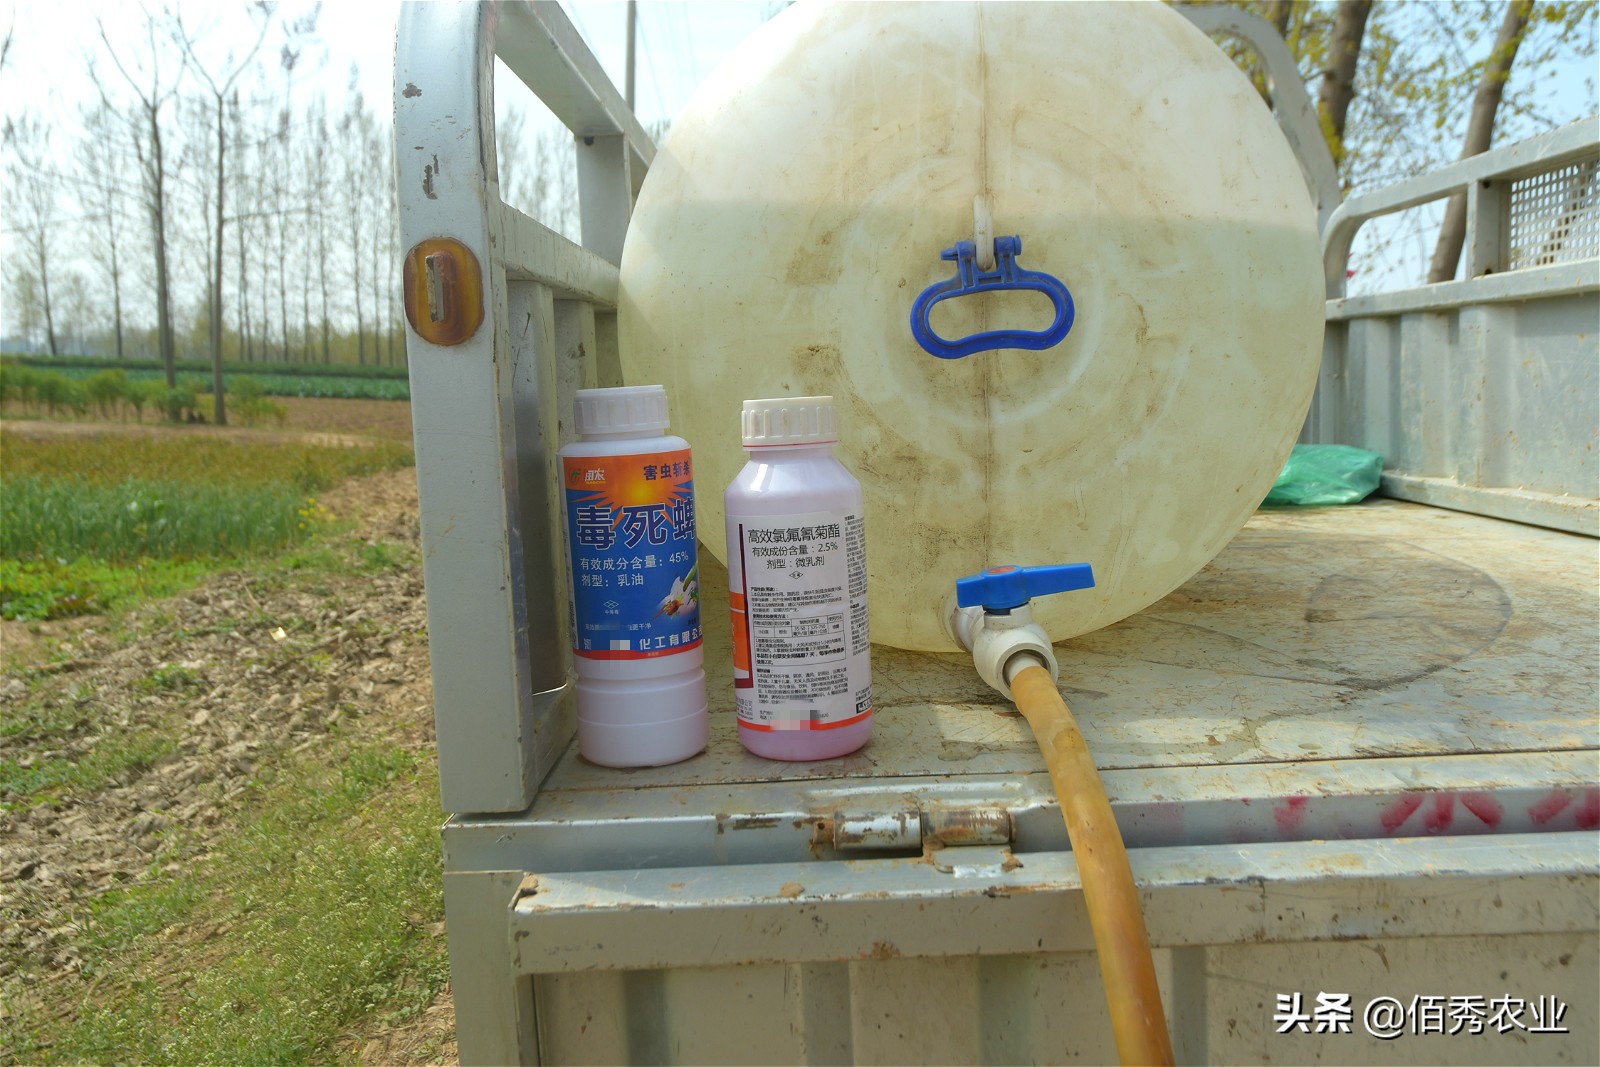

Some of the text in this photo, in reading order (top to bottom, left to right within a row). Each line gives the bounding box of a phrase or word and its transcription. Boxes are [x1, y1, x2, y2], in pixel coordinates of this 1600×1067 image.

[577, 496, 696, 551] 毒死蜱
[747, 523, 840, 544] 高效氯氟氰菊酯
